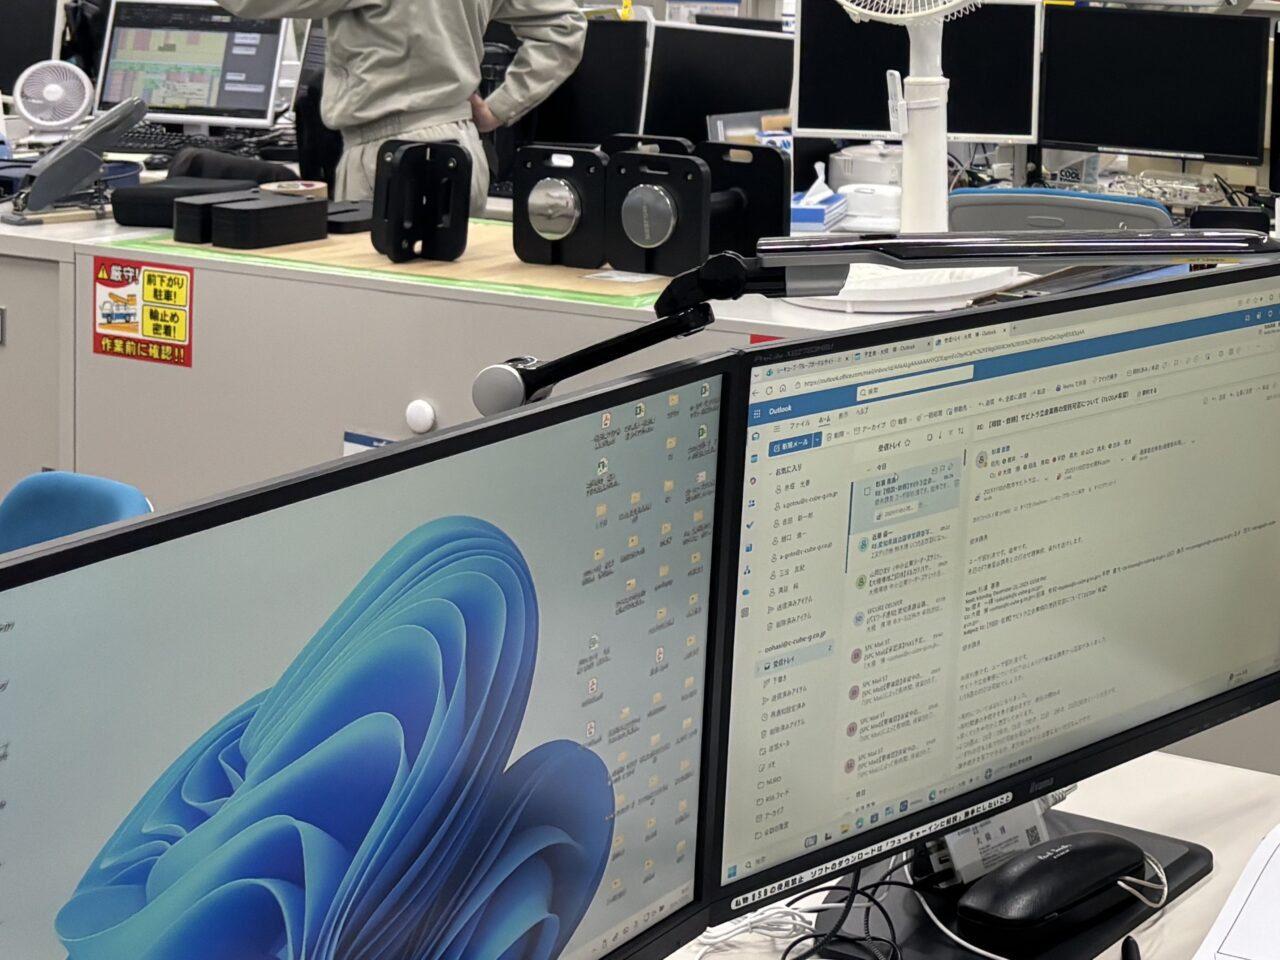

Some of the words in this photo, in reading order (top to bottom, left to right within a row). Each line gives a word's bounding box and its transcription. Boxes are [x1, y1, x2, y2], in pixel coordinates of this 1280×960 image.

[1060, 169, 1080, 180] COOL
[110, 264, 140, 285] 厳守!
[146, 273, 184, 289] 前下がり
[153, 288, 177, 303] 駐車!
[149, 308, 180, 324] 輪止め
[152, 323, 176, 339] 密着!
[101, 336, 185, 362] 作業前に確認!!
[768, 404, 792, 415] Outlook
[775, 463, 802, 476] お気に入り
